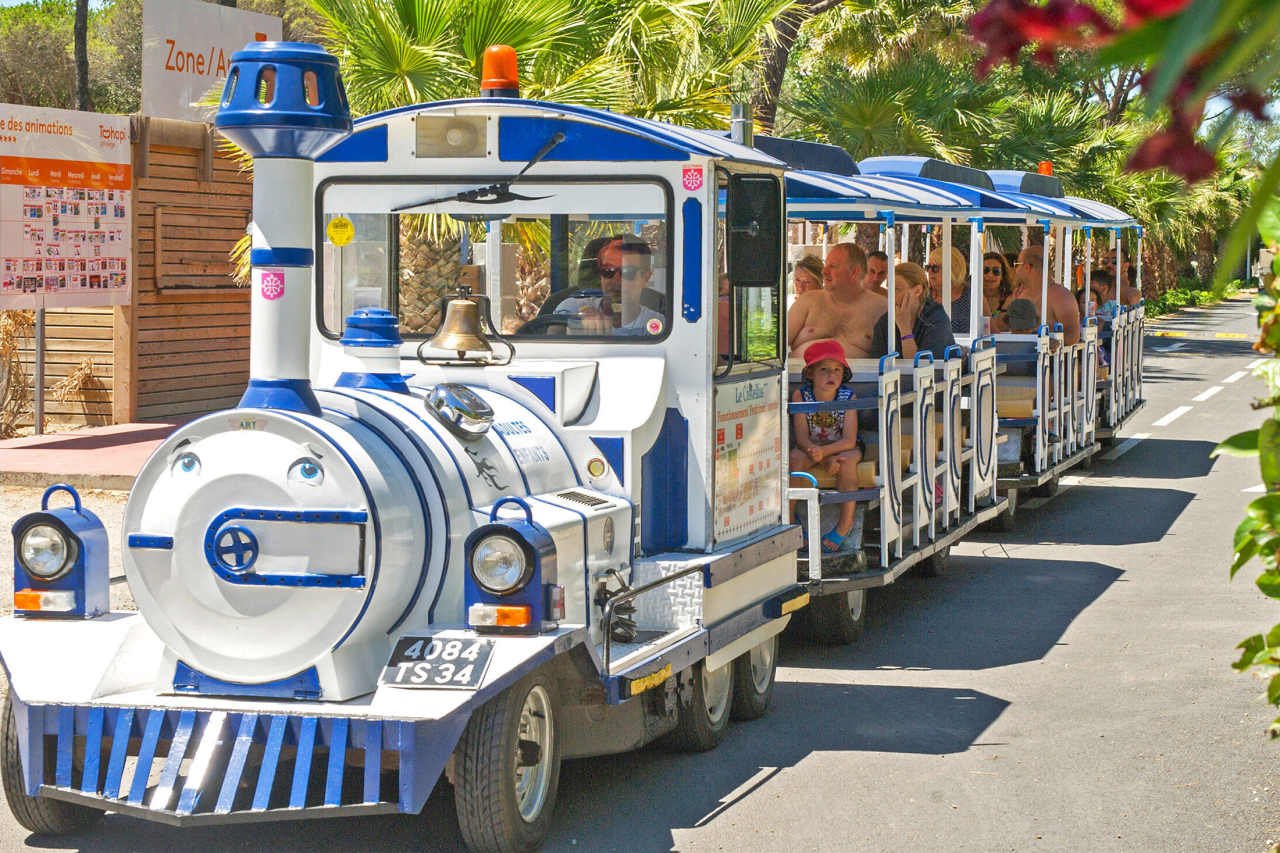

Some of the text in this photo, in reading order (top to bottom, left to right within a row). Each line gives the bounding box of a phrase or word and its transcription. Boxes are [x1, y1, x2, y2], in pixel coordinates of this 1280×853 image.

[7, 117, 23, 132] des
[25, 119, 73, 137] animations
[404, 639, 481, 662] 4084
[395, 662, 475, 685] TS 34
